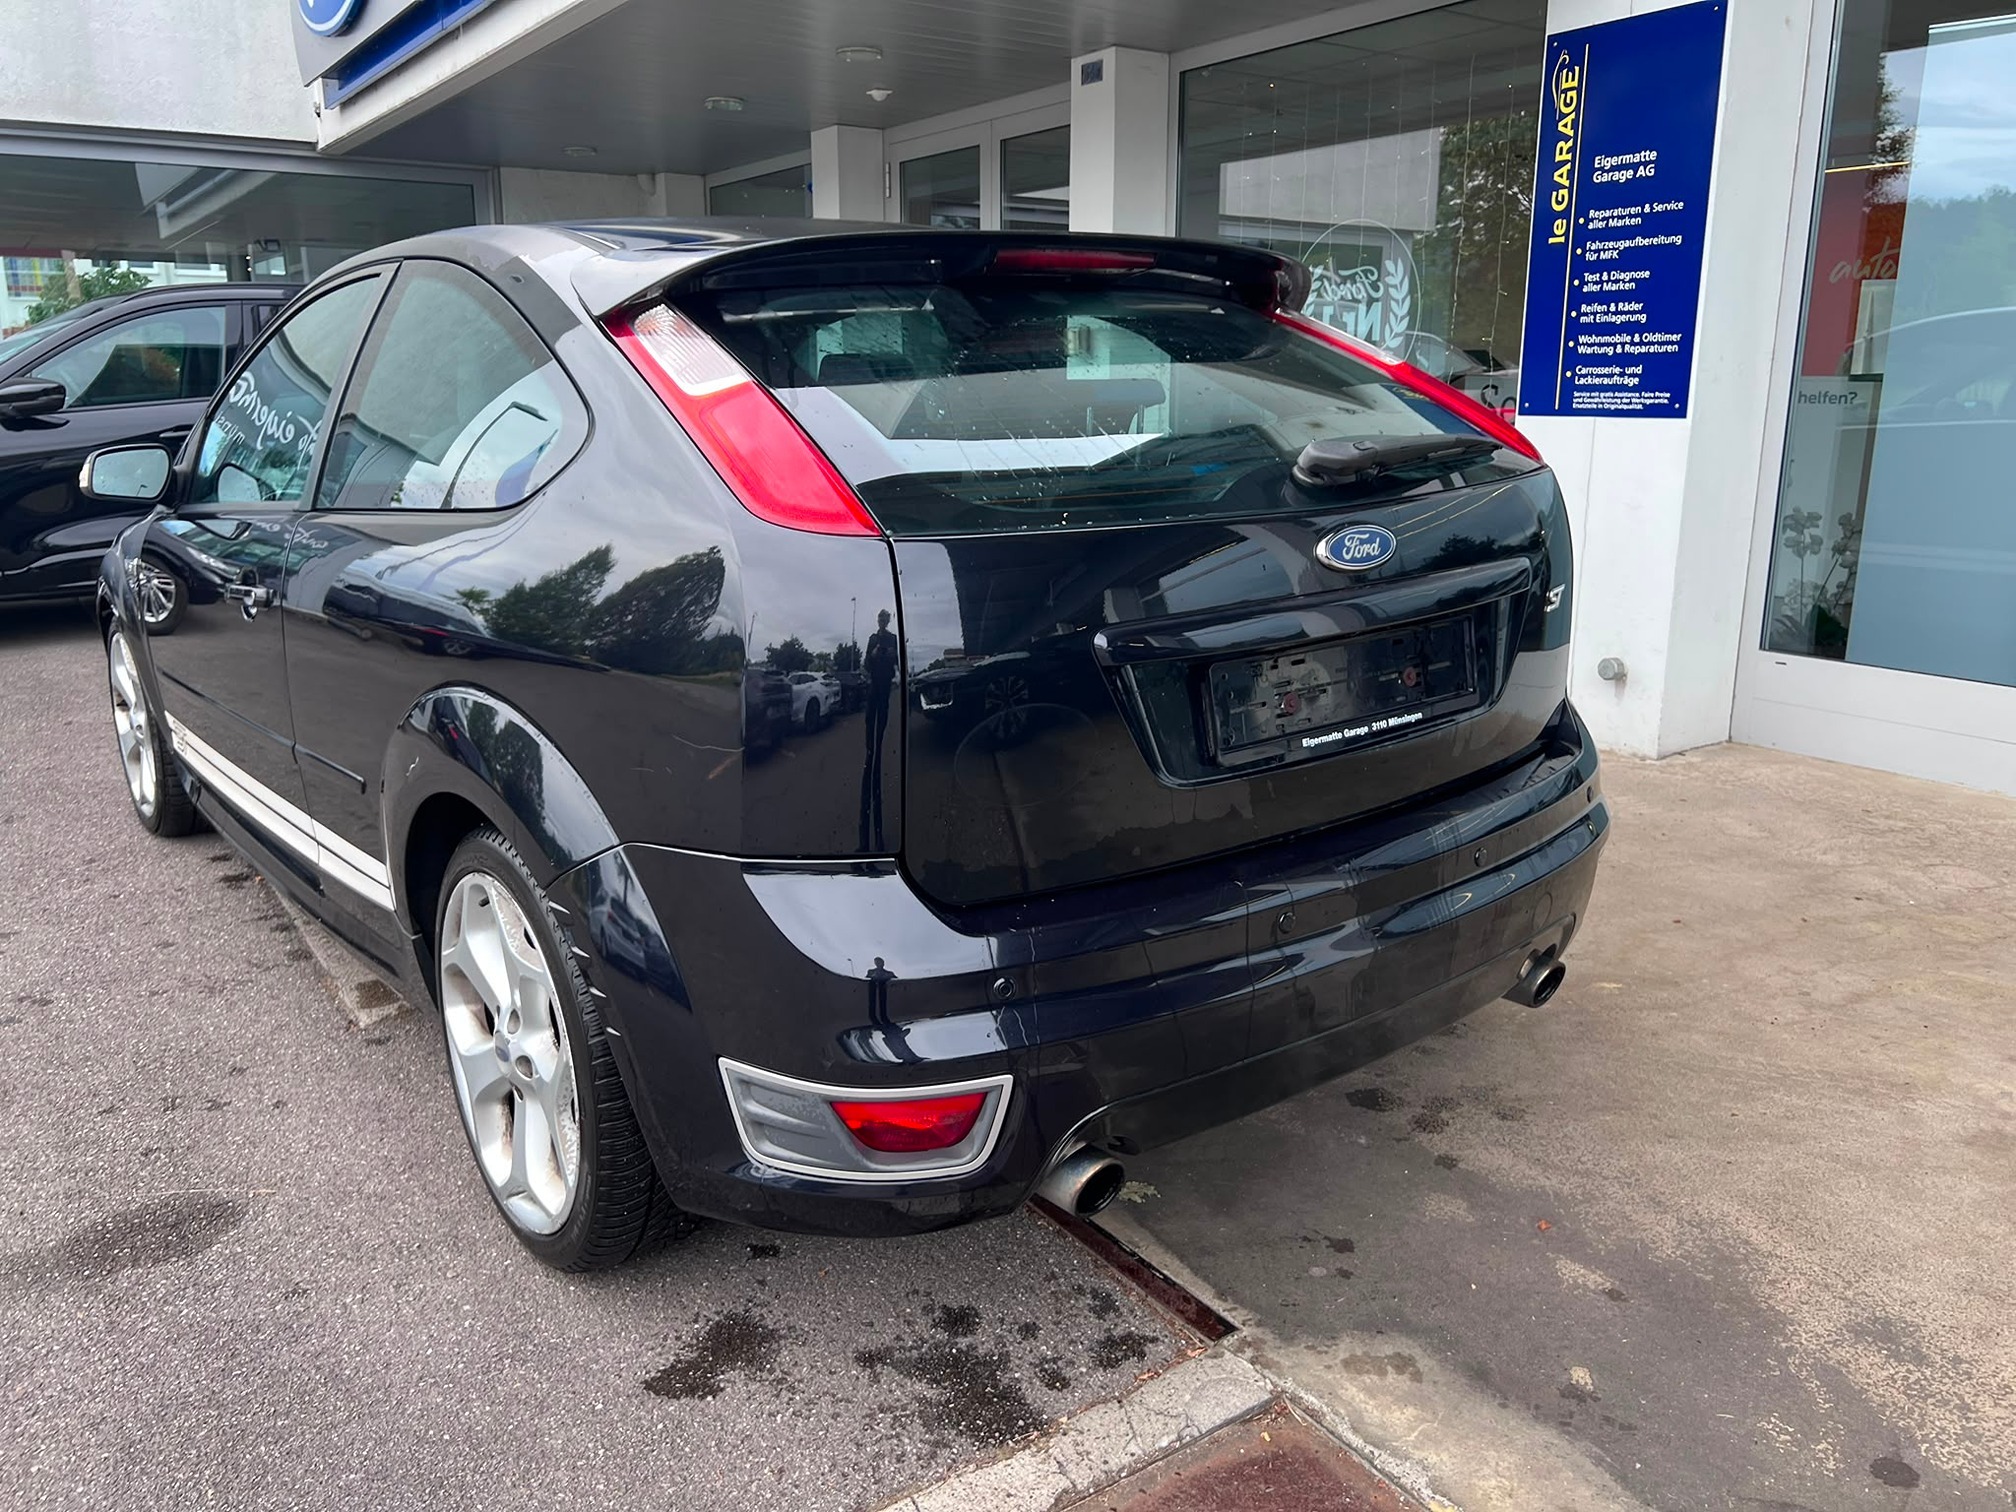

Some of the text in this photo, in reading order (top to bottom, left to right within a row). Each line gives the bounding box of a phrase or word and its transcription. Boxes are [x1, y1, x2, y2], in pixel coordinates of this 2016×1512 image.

[1548, 65, 1579, 244] le GARAGE
[1594, 150, 1658, 170] Eigermatte
[1593, 164, 1656, 184] Garage AG
[1589, 201, 1684, 220] Reparaturen & Service
[1587, 217, 1642, 230] aller Marken
[1586, 235, 1683, 251] Fahrzeugaufbereitung
[1585, 250, 1619, 261] für MFK
[1829, 235, 1900, 284] auto
[1584, 270, 1651, 282] Test & Diagnose
[1582, 281, 1636, 293] aller Marken
[1581, 301, 1644, 313] Reifen & Räder
[1580, 313, 1647, 325] mit Einlagerung
[1578, 332, 1682, 344] Wohnmobile & Oldtimer
[1578, 343, 1679, 356] Wartung & Reparaturen
[1576, 364, 1643, 375] Carrosserie- und
[1574, 376, 1640, 387] Lackieraufträge
[1797, 390, 1858, 405] helfen?
[1342, 533, 1381, 560] Ford
[1302, 712, 1423, 748] Eigermatte Garage 3110 Münsingen
